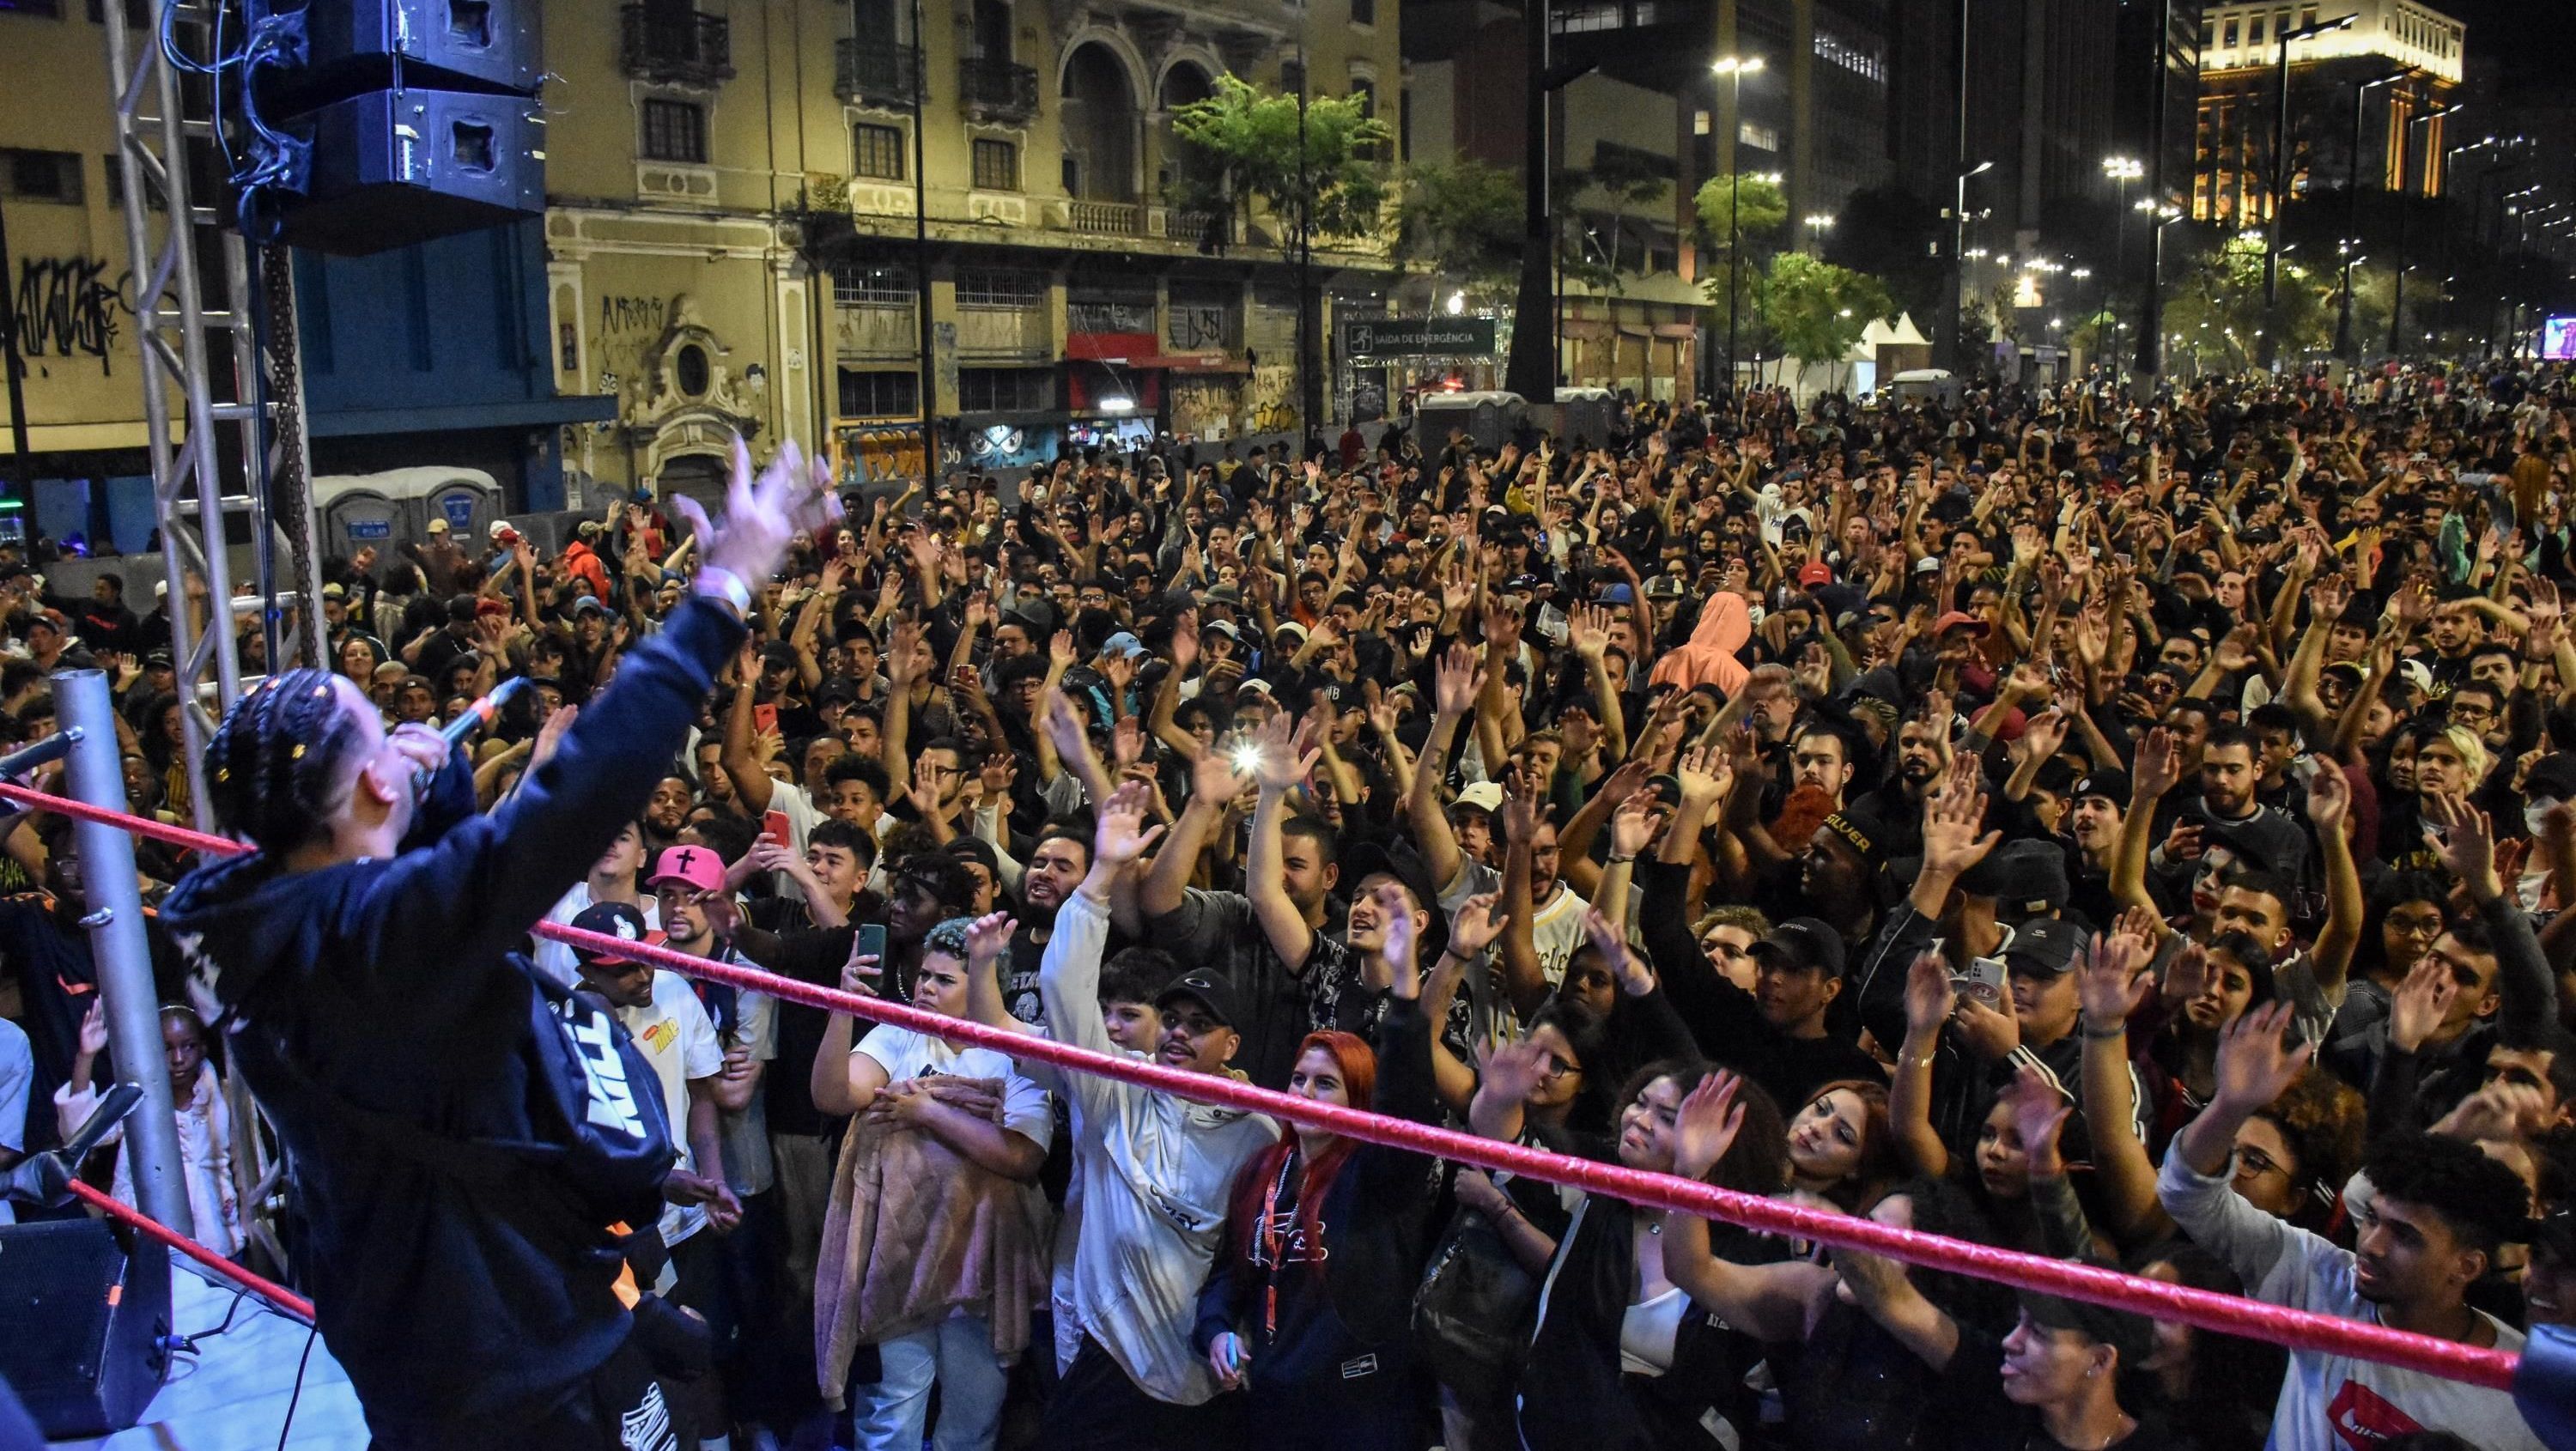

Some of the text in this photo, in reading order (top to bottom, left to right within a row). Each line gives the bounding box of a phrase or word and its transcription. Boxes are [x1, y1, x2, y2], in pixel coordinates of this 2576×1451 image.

[1375, 332, 1474, 344] SAÍDA DE EMERGÊNCIA
